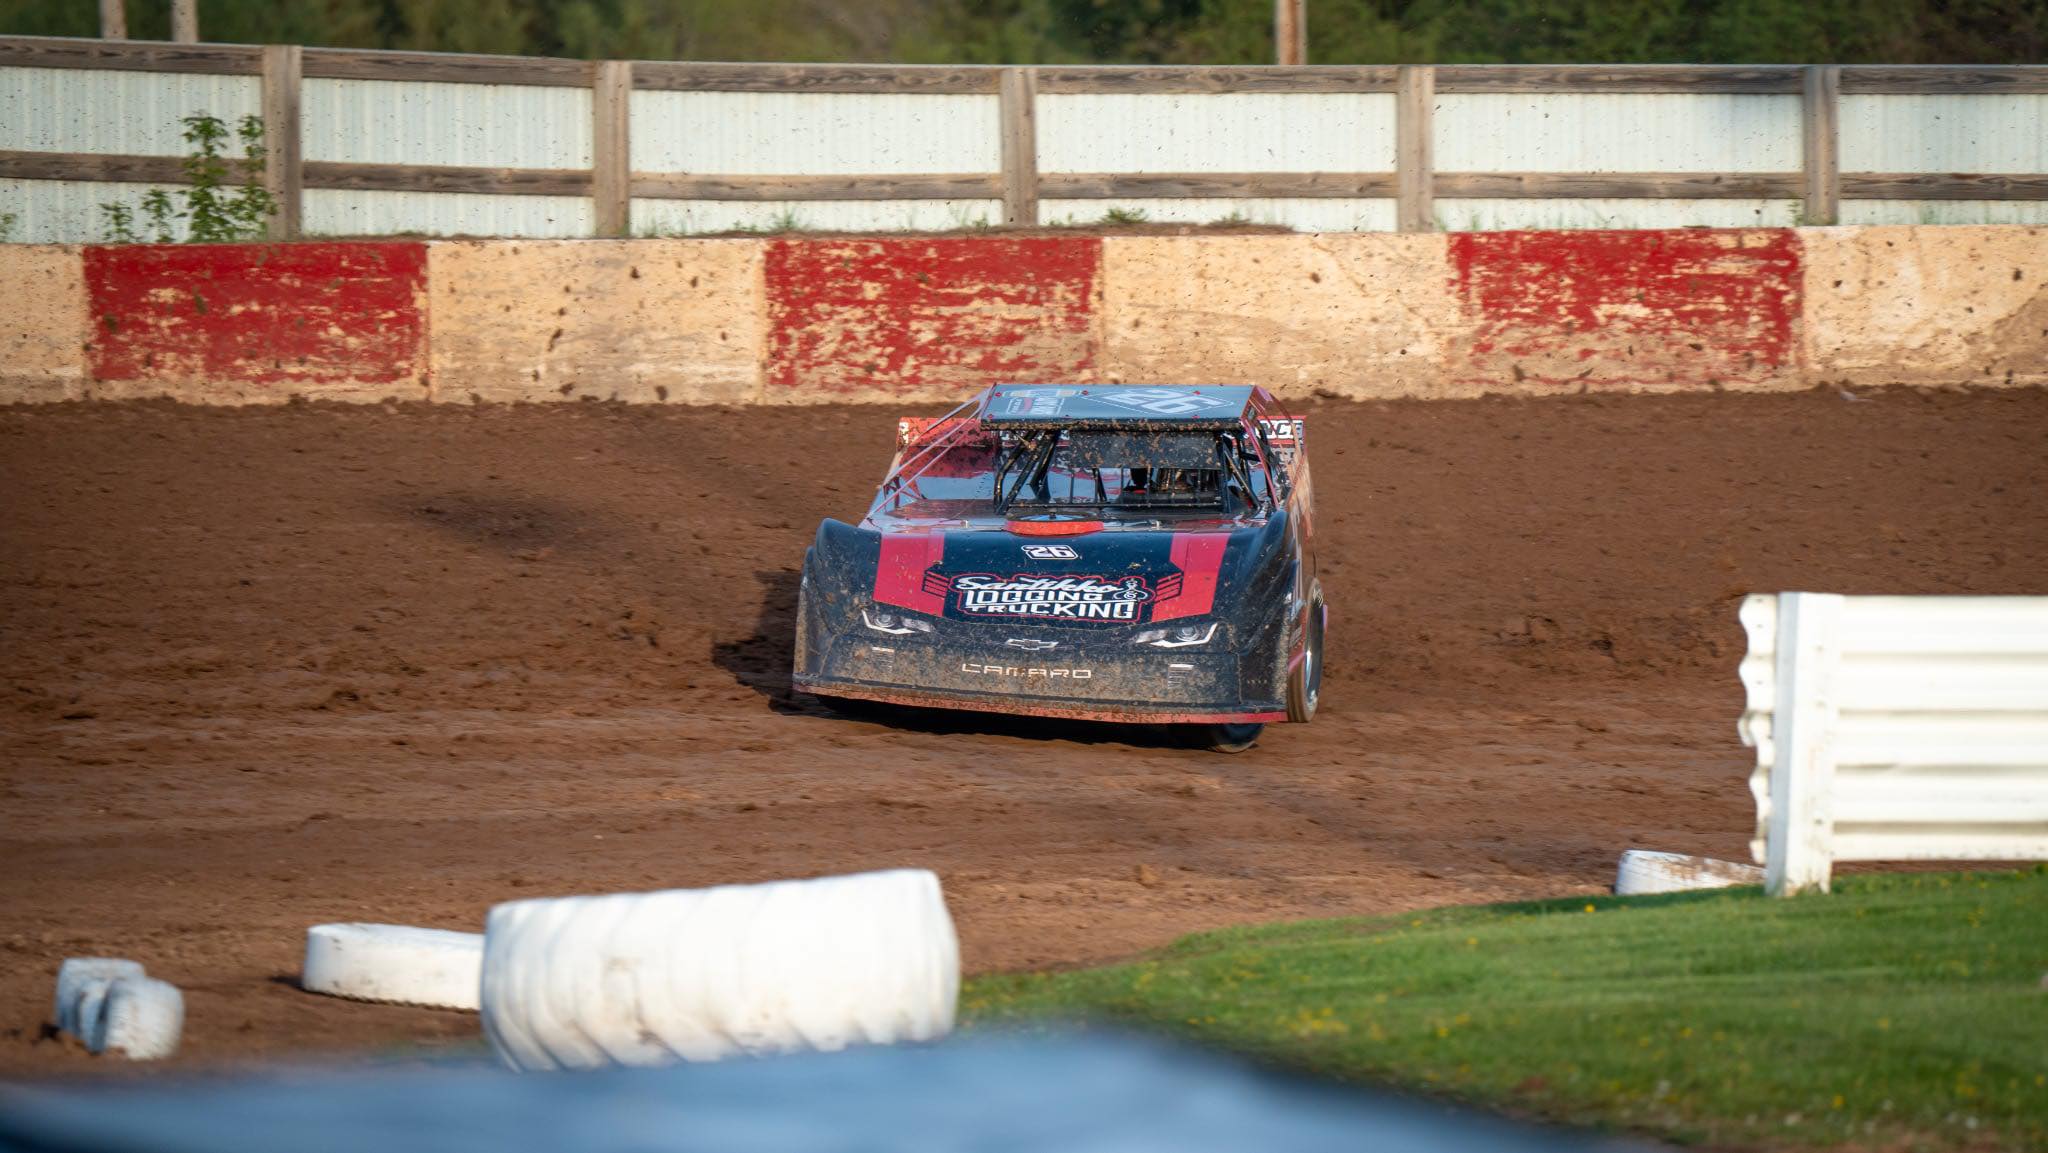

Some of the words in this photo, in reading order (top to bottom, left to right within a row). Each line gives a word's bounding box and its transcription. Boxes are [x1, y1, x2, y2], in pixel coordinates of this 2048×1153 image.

[1101, 388, 1224, 414] 26
[1026, 545, 1072, 559] 26
[965, 590, 1103, 605] LOGGING
[966, 602, 1135, 619] TRUCKING
